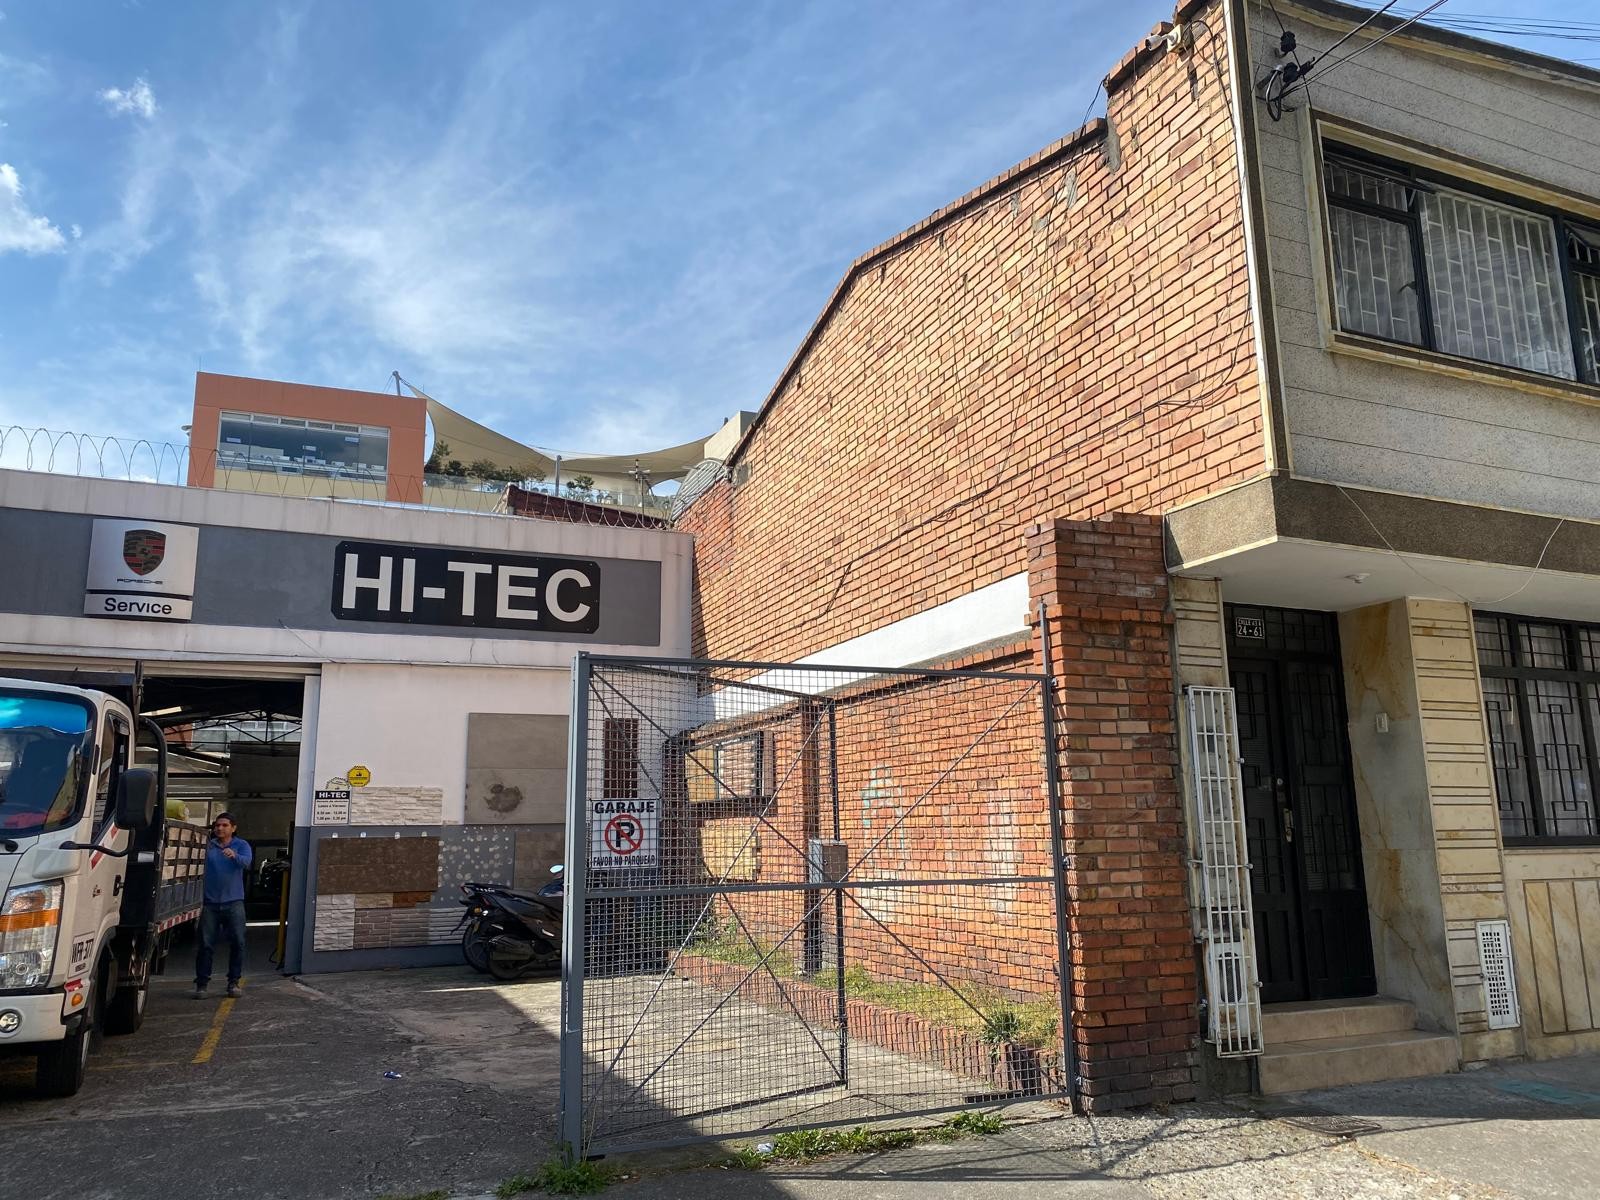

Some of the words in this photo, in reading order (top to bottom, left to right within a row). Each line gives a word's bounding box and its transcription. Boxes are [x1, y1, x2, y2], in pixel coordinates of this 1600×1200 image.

[341, 553, 592, 622] HI-TEC
[104, 597, 173, 614] Service
[594, 801, 655, 814] GARAJE
[593, 856, 613, 867] FAVOR
[614, 856, 623, 866] NO
[624, 854, 656, 866] PARQUEAR
